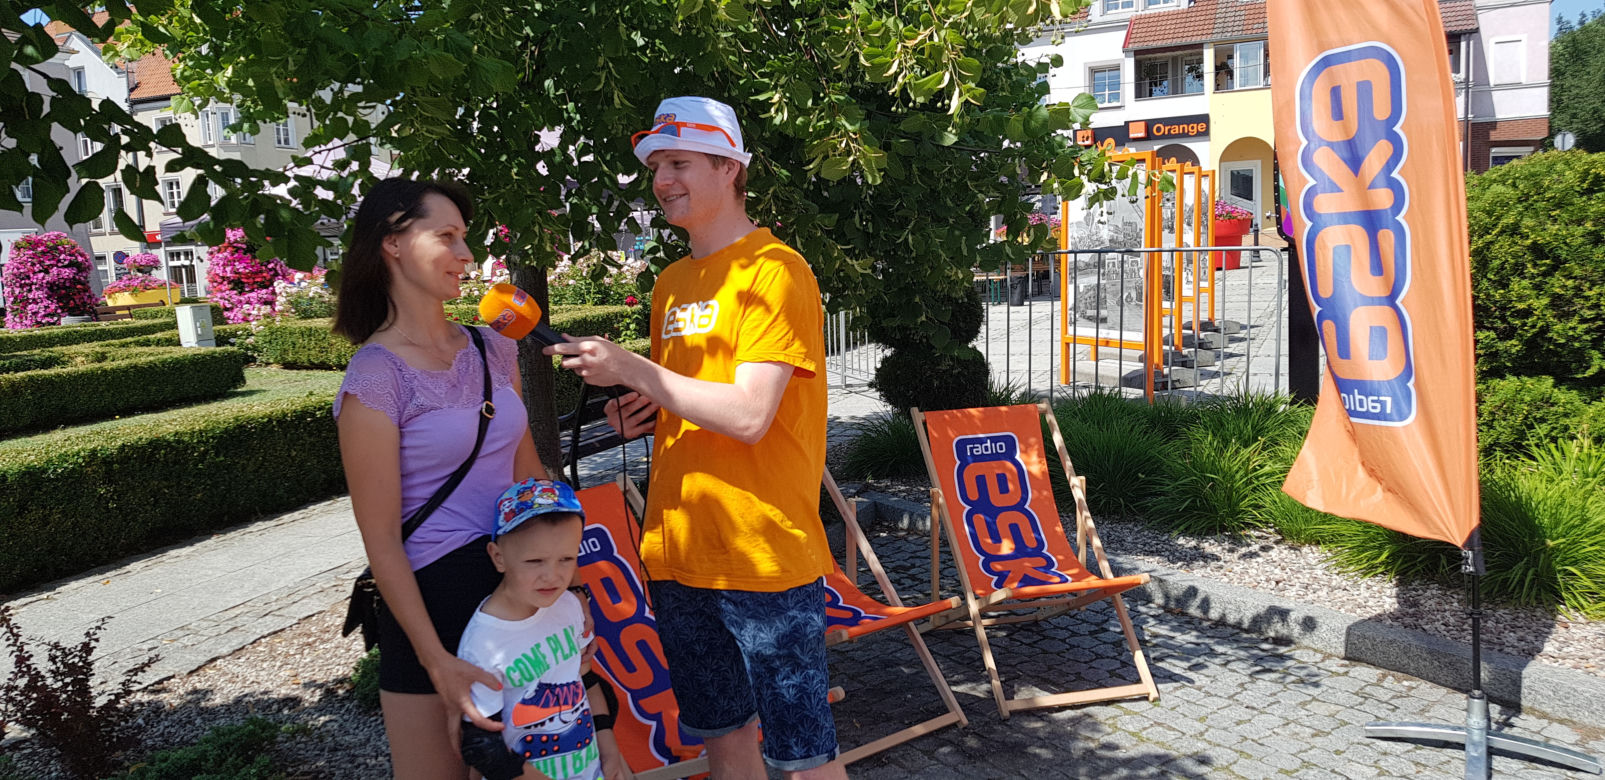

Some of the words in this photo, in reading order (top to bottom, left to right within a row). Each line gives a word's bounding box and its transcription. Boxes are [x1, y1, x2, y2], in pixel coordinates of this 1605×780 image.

[1153, 122, 1206, 136] Orange
[967, 439, 1006, 456] radio
[505, 642, 550, 688] COME
